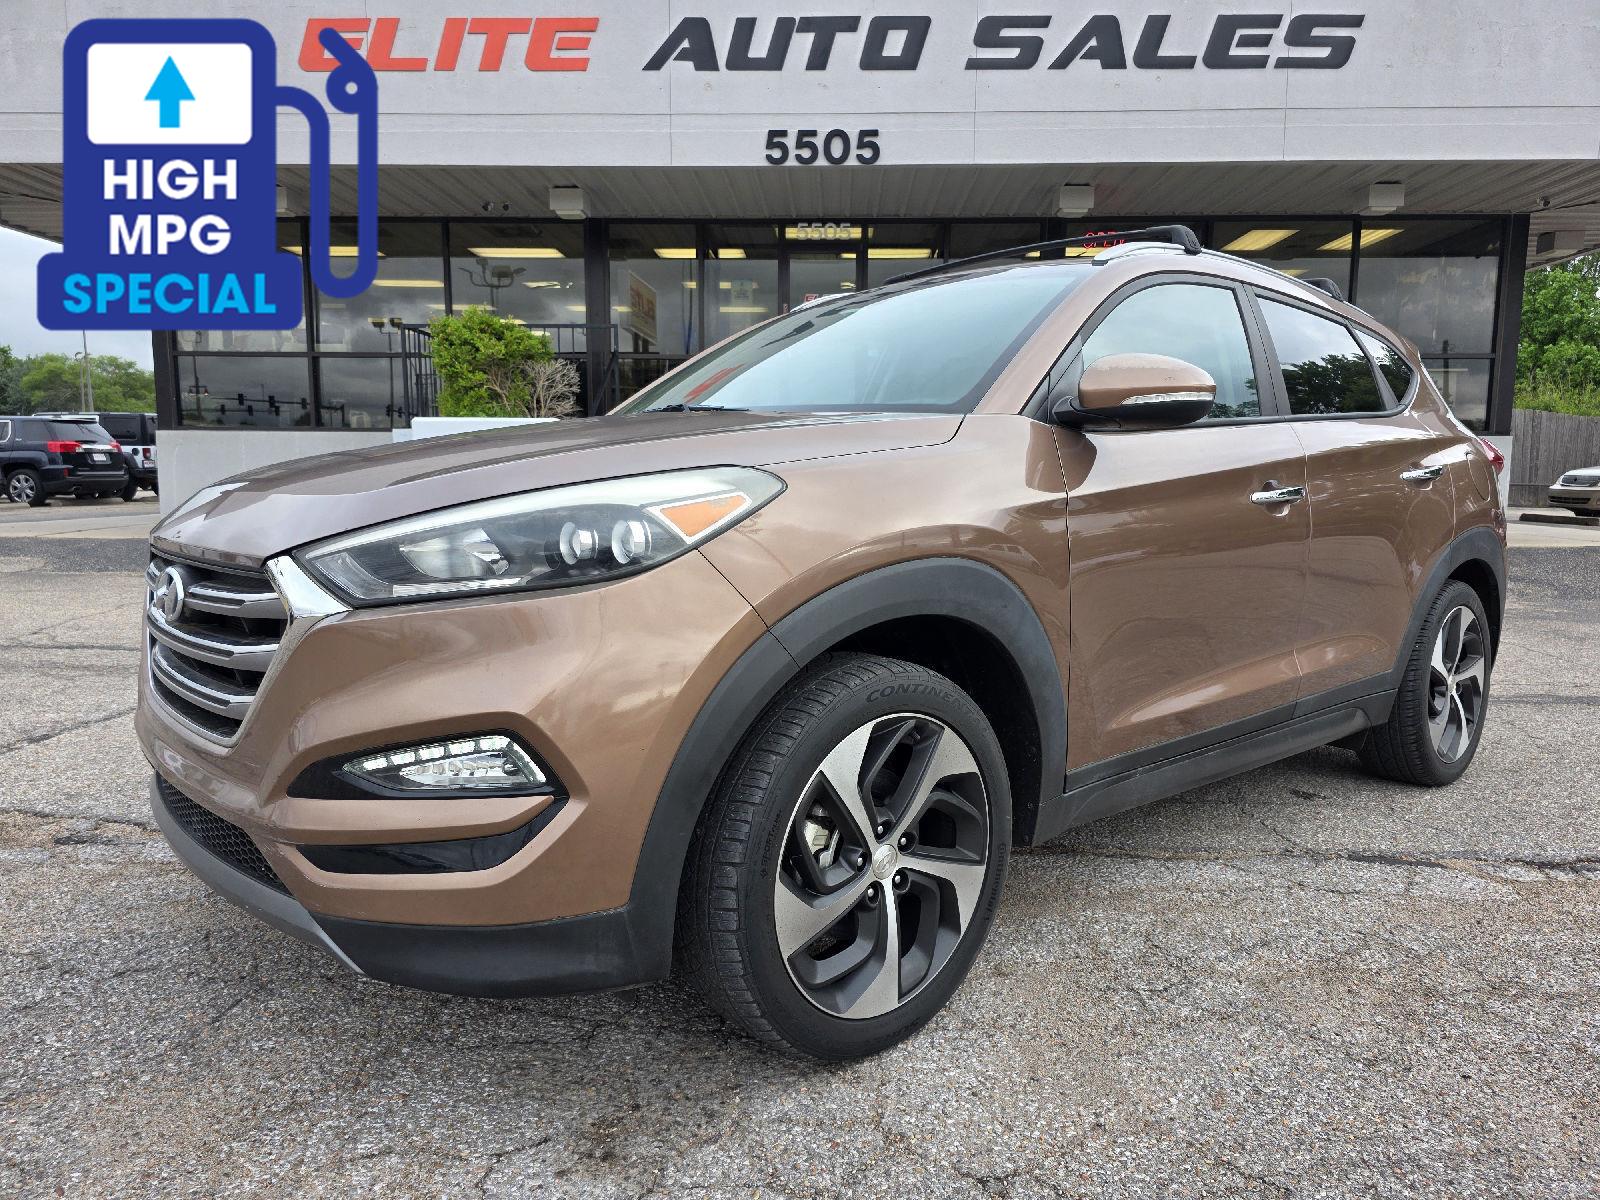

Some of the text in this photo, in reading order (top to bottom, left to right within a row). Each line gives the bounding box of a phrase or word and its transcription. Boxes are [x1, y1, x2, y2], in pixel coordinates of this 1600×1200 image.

[298, 14, 1366, 72] ELITE AUTO SALES
[765, 129, 881, 165] 5505
[797, 223, 851, 240] 5505
